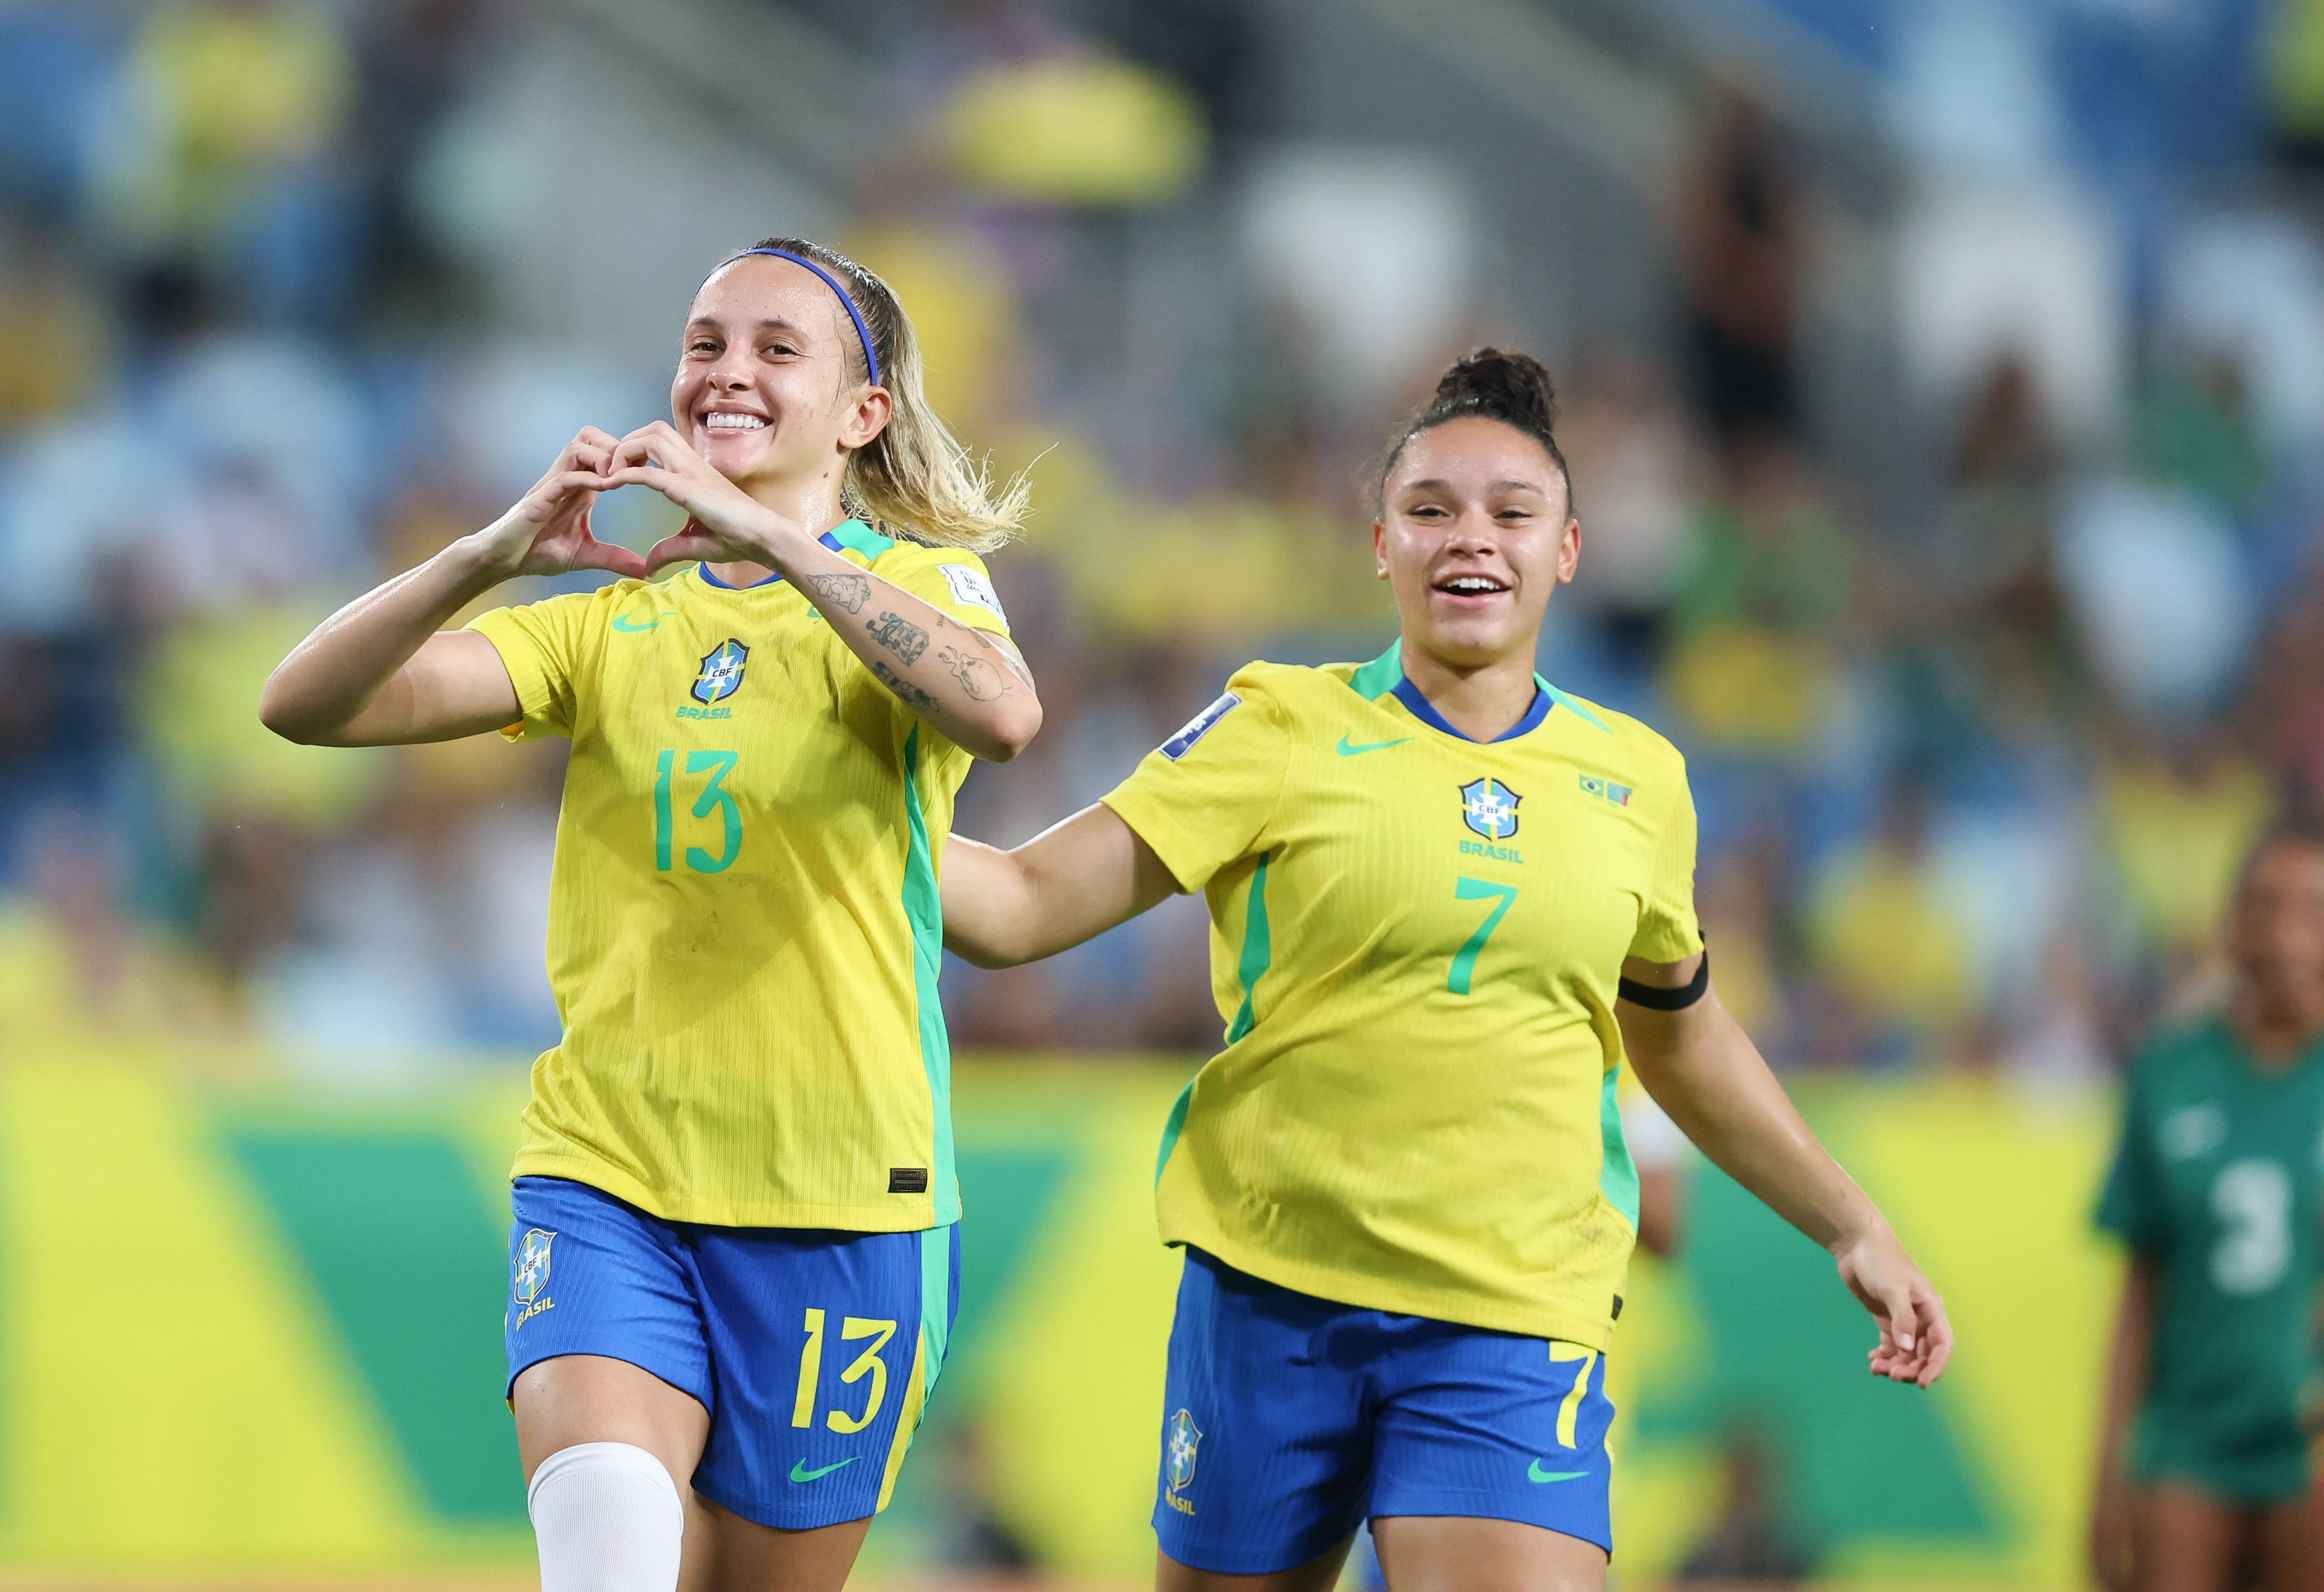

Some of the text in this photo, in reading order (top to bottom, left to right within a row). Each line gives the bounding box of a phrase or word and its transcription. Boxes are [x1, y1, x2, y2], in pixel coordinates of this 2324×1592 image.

[712, 667, 732, 677] CBF
[675, 706, 732, 719] BRASIL
[654, 750, 743, 873] 13
[1479, 805, 1502, 814] CBF
[1459, 840, 1524, 863] BRASIL
[1448, 876, 1519, 995] 7
[524, 1257, 537, 1273] CBF
[791, 1308, 897, 1434] 13
[1549, 1340, 1598, 1450] 7
